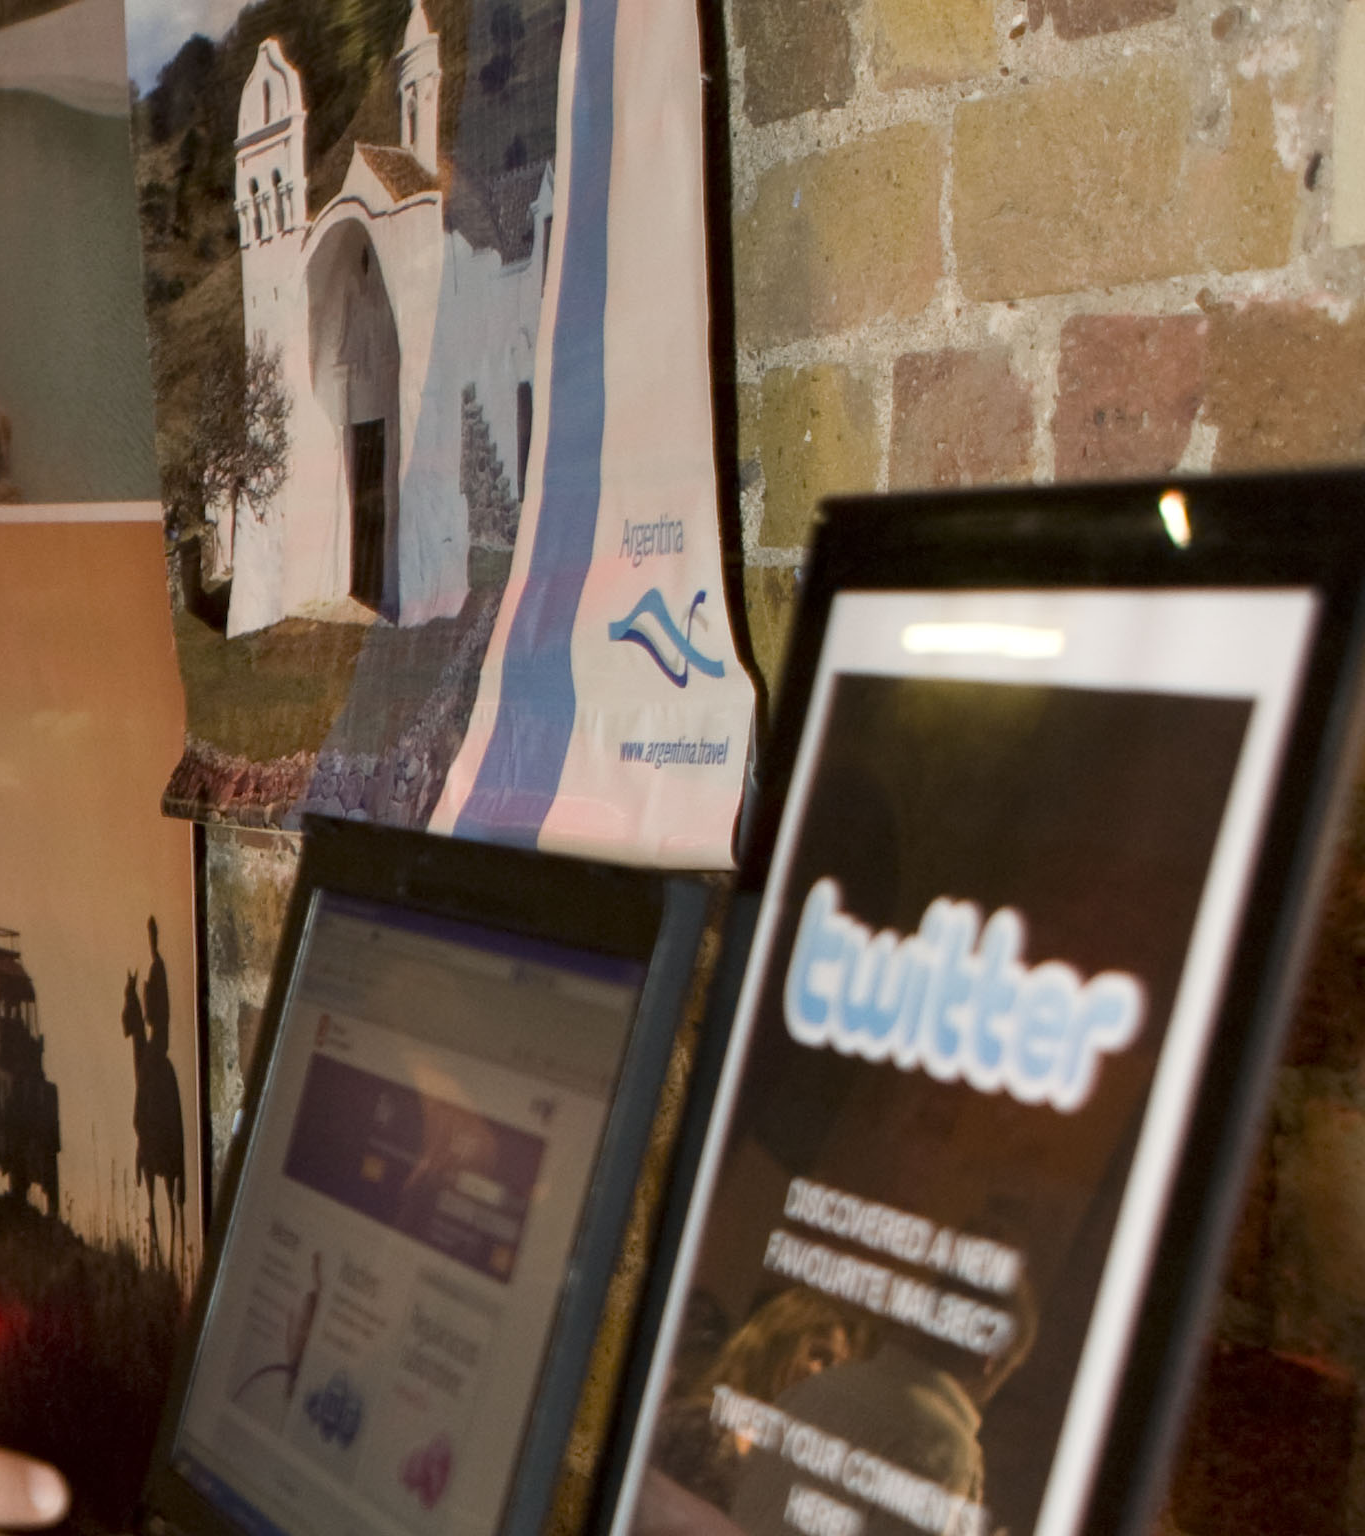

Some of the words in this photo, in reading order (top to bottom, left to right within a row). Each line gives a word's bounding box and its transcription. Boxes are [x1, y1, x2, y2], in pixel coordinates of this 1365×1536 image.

[619, 514, 684, 568] Argentina
[619, 736, 730, 770] www.argentina.travel
[783, 876, 1146, 1114] twitter
[763, 1228, 894, 1315] FAVOURITE
[783, 1176, 936, 1266] DISCOVERED
[926, 1225, 957, 1277] A
[710, 1383, 787, 1450] TWEET
[780, 1417, 850, 1482] YOUR
